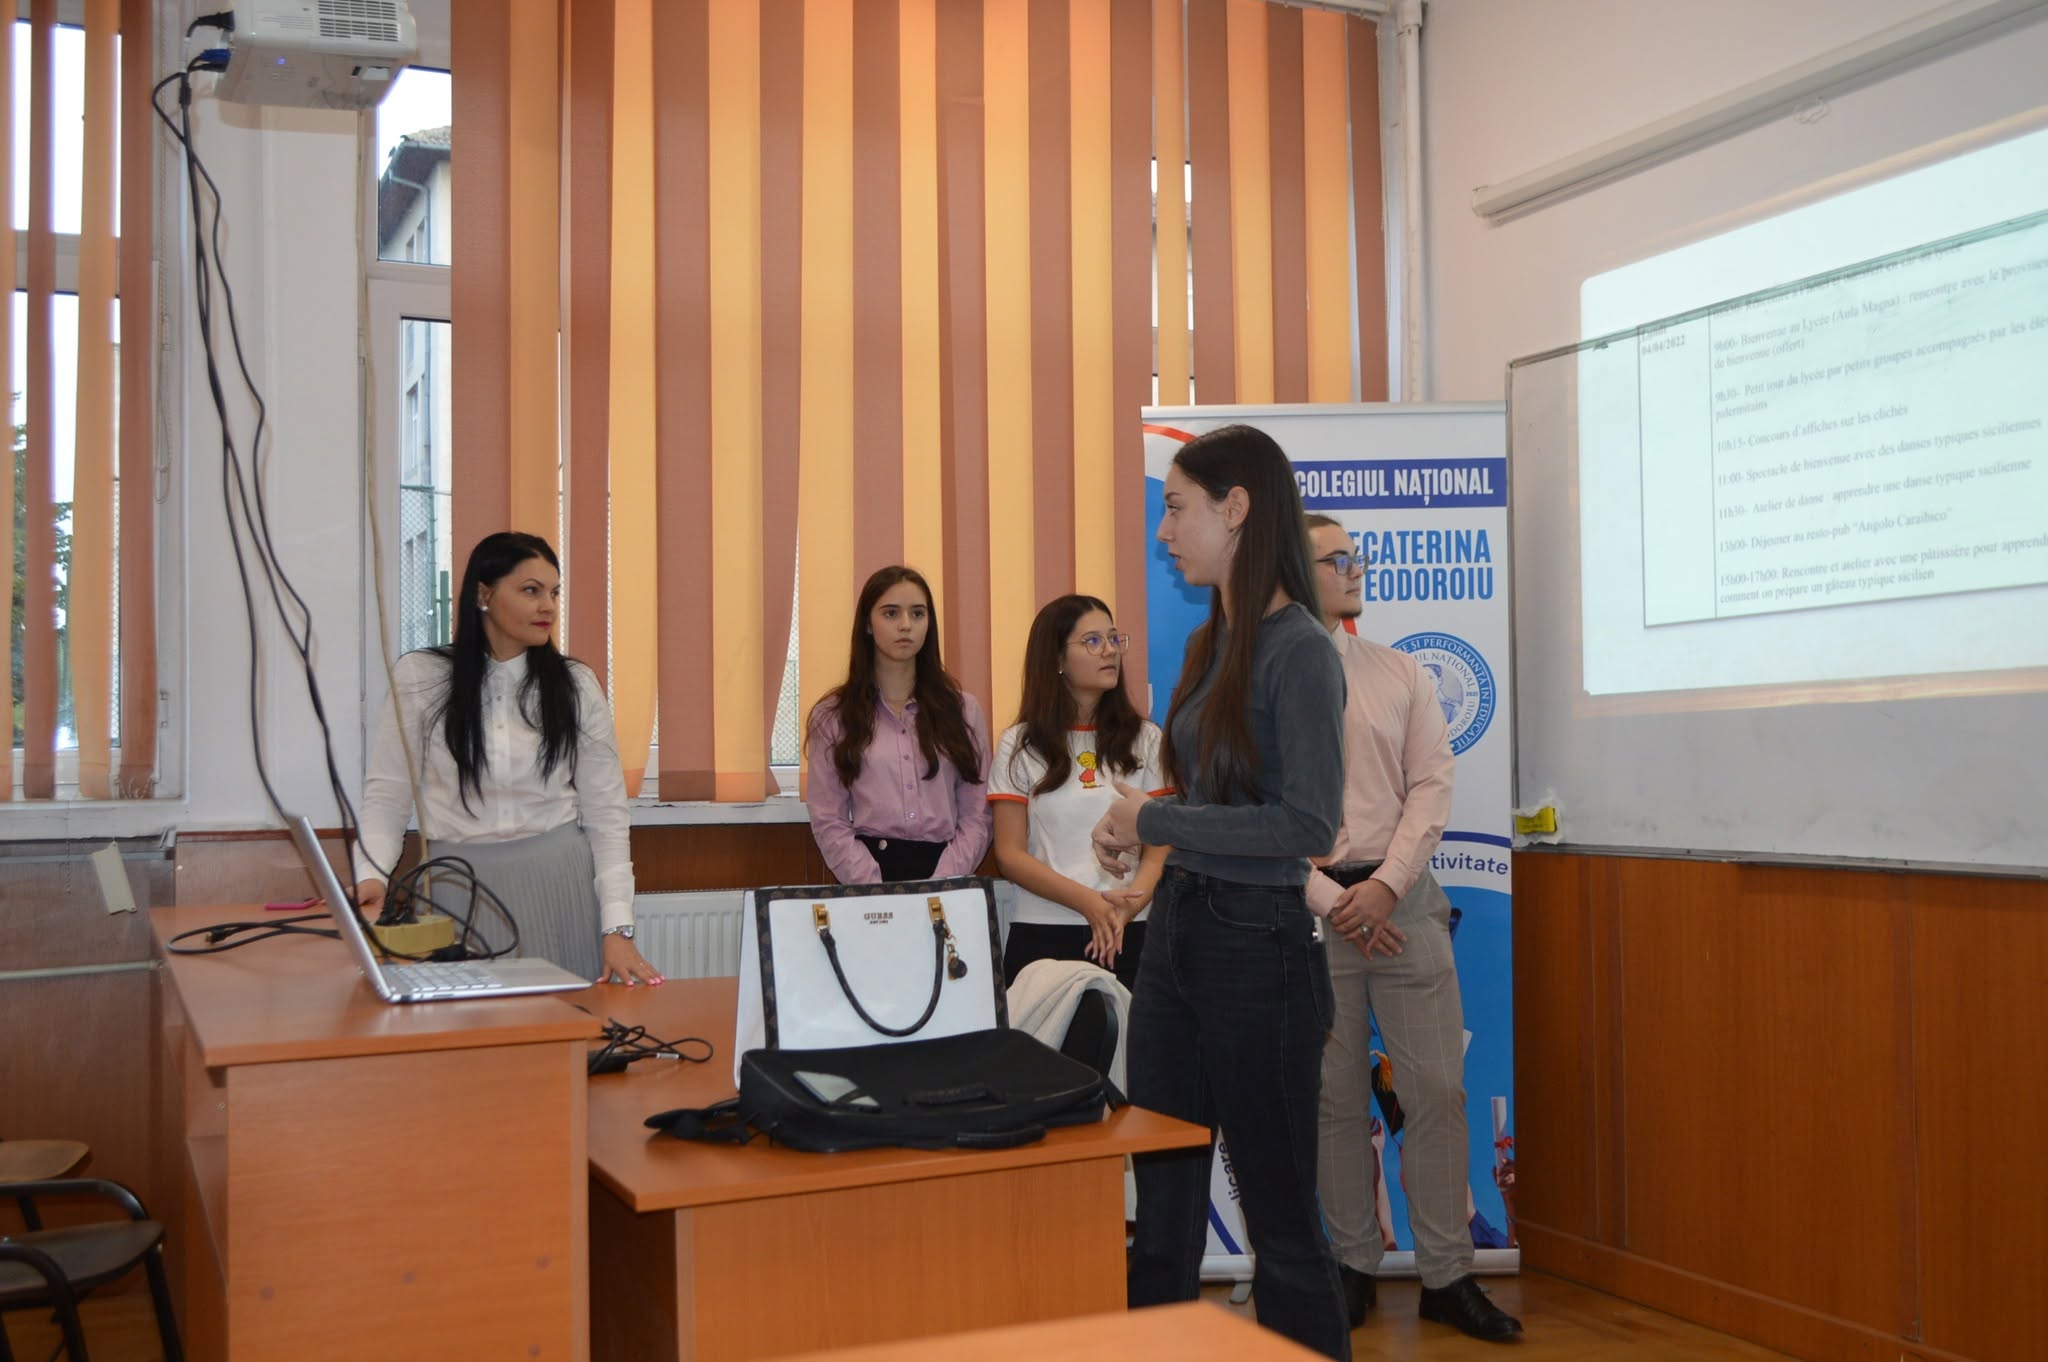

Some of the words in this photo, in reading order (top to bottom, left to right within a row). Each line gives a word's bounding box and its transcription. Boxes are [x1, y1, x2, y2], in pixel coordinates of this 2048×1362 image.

[1741, 326, 1787, 346] Bienvenue
[1790, 321, 1800, 333] au
[1908, 280, 1958, 302] rencontre
[1962, 274, 1985, 290] avec
[1989, 268, 1998, 281] le
[1715, 356, 1725, 369] de
[1726, 347, 1769, 366] bienvenue
[1787, 374, 1798, 386] du
[1827, 366, 1841, 380] par
[1874, 350, 1913, 368] groupes
[1989, 327, 2006, 343] par
[1748, 430, 1790, 447] Concours
[1857, 411, 1872, 424] les
[1874, 402, 1908, 421] clichés
[1746, 463, 1788, 482] Spectacle
[1790, 460, 1801, 473] de
[1804, 452, 1851, 470] bienvenue
[1853, 447, 1875, 461] avec
[1878, 444, 1895, 457] des
[1897, 435, 1932, 453] danses
[1934, 429, 1979, 448] typiques
[1982, 417, 2041, 437] siciliennes
[1294, 469, 1390, 498] COLEGIUL
[1394, 467, 1494, 506] NAȚIONAL
[1752, 497, 1782, 514] Atelier
[1785, 495, 1796, 508] de
[1798, 492, 1824, 506] danse
[1832, 483, 1880, 502] apprendre
[1903, 474, 1933, 488] danse
[1935, 467, 1975, 487] typique
[1978, 457, 2032, 476] sicilienne
[1751, 534, 1791, 549] Déjeuner
[1793, 531, 1804, 542] au
[1806, 523, 1850, 541] resto-pub
[1782, 562, 1828, 579] Rencontre
[1830, 561, 1839, 573] et
[1842, 556, 1871, 570] atelier
[1874, 554, 1897, 567] avec
[1899, 552, 1917, 563] une
[1920, 543, 1970, 564] pâtissière
[1972, 541, 1998, 558] pour
[1364, 567, 1493, 602] EODOROIU
[1720, 588, 1759, 604] comment
[1762, 588, 1773, 599] on
[1775, 583, 1808, 599] prépare
[1811, 583, 1823, 593] un
[1825, 578, 1856, 595] gâteau
[1858, 575, 1895, 592] typique
[1897, 567, 1934, 582] sicilien
[1450, 701, 1475, 736] DOROIU
[1430, 853, 1508, 875] tivitate
